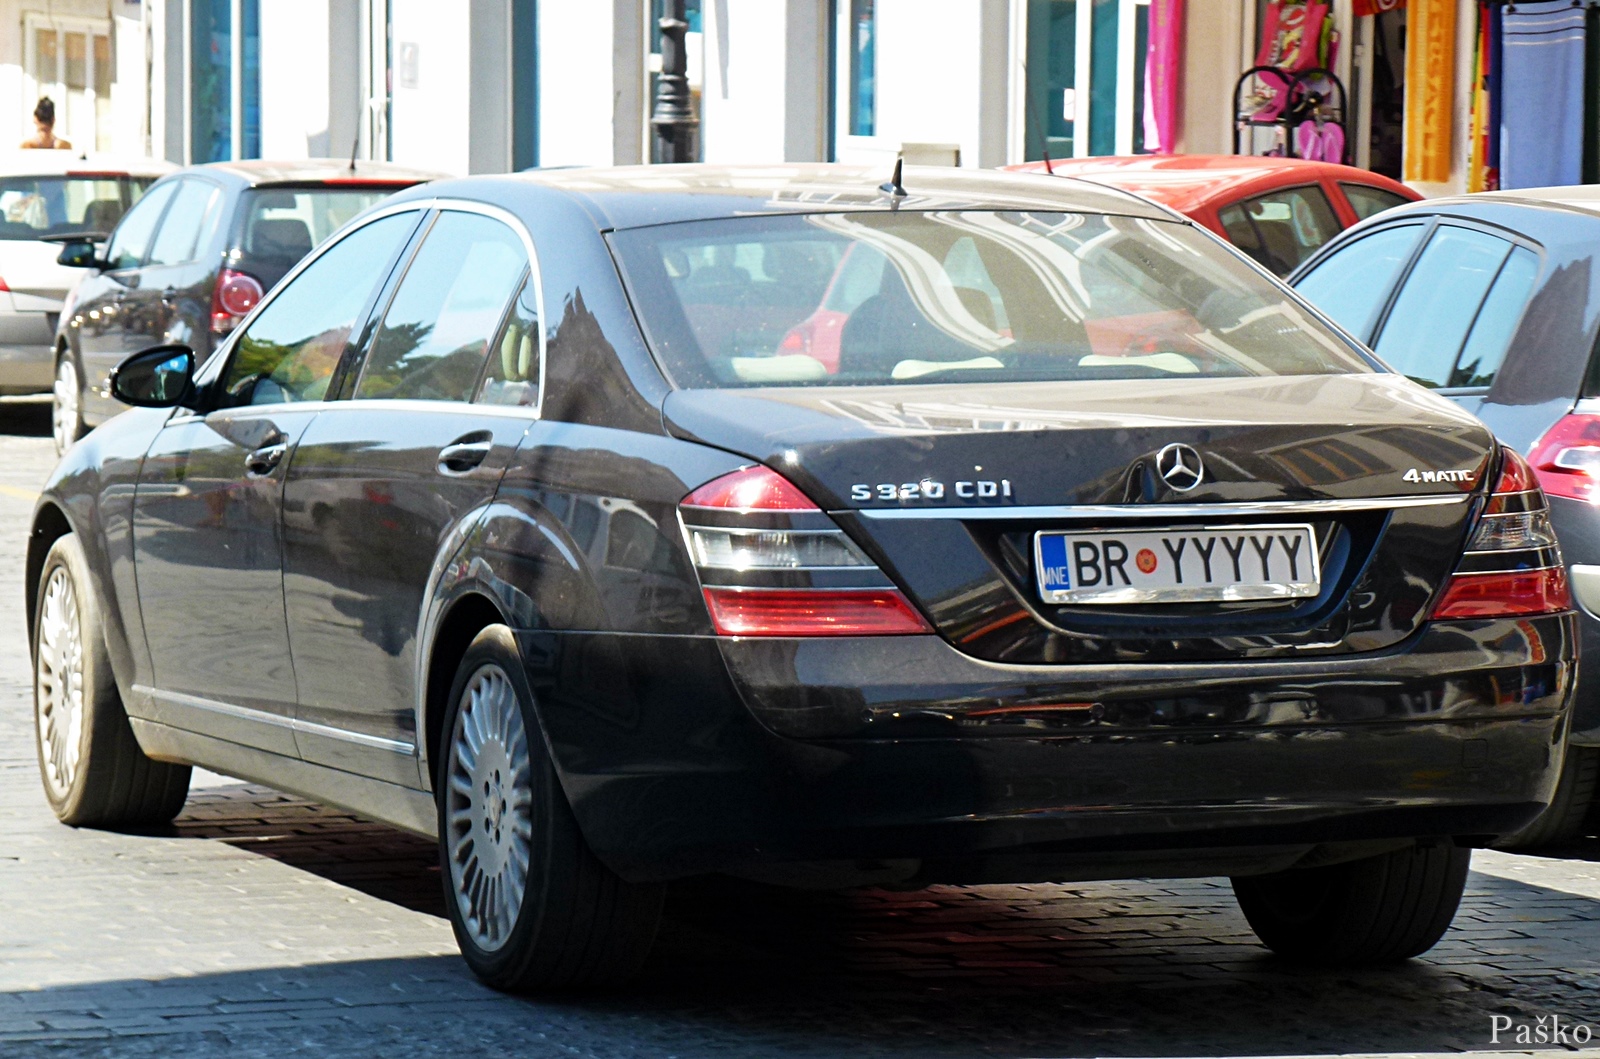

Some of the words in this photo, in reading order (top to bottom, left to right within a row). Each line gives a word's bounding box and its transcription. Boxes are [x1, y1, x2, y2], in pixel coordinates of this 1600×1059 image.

[1402, 468, 1475, 484] 4MATIC
[851, 484, 872, 501] S
[876, 479, 945, 501] 320
[955, 479, 1012, 498] CDI
[1072, 539, 1132, 587] BR
[1162, 535, 1302, 583] YYYYY
